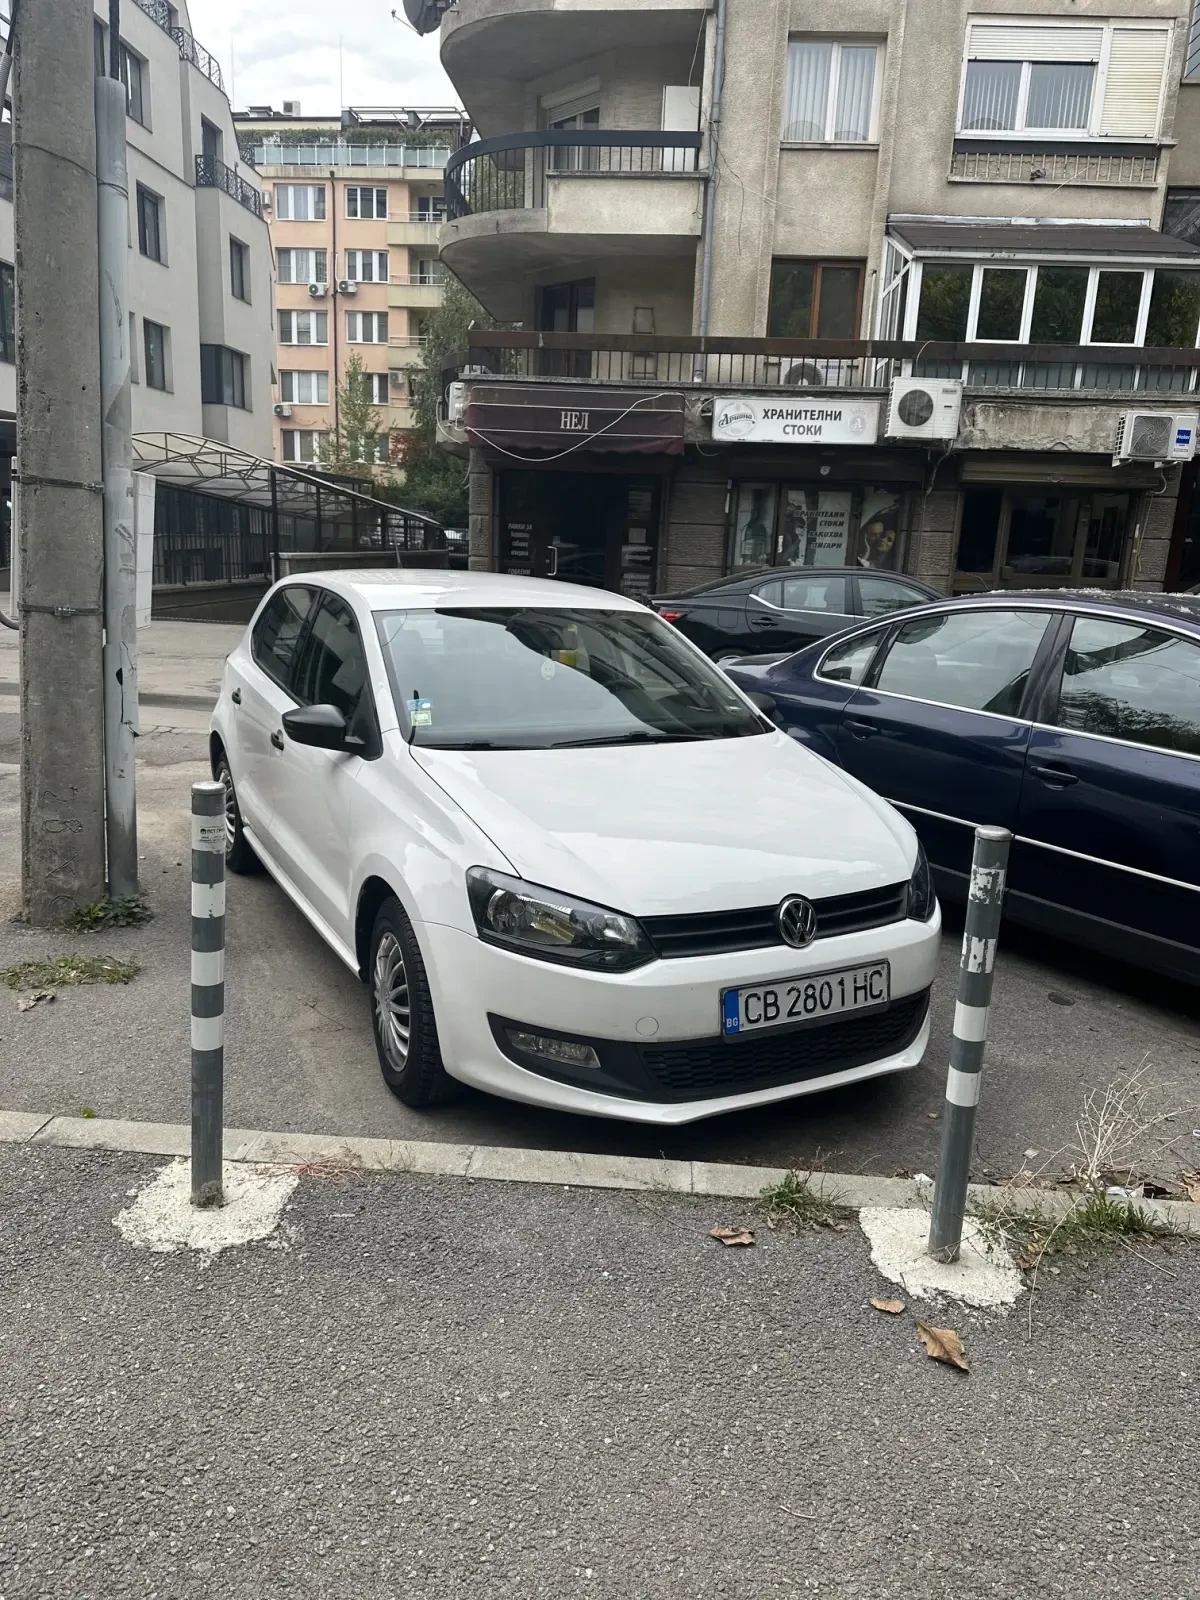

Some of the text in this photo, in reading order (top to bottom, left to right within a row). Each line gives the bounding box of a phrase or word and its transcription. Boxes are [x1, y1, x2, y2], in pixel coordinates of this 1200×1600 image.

[560, 411, 590, 430] НЕЛ
[762, 408, 842, 421] ХРАНИТЕЛНИ
[782, 424, 822, 436] СТОКИ
[786, 977, 845, 1018] 2801
[726, 1017, 739, 1028] BG
